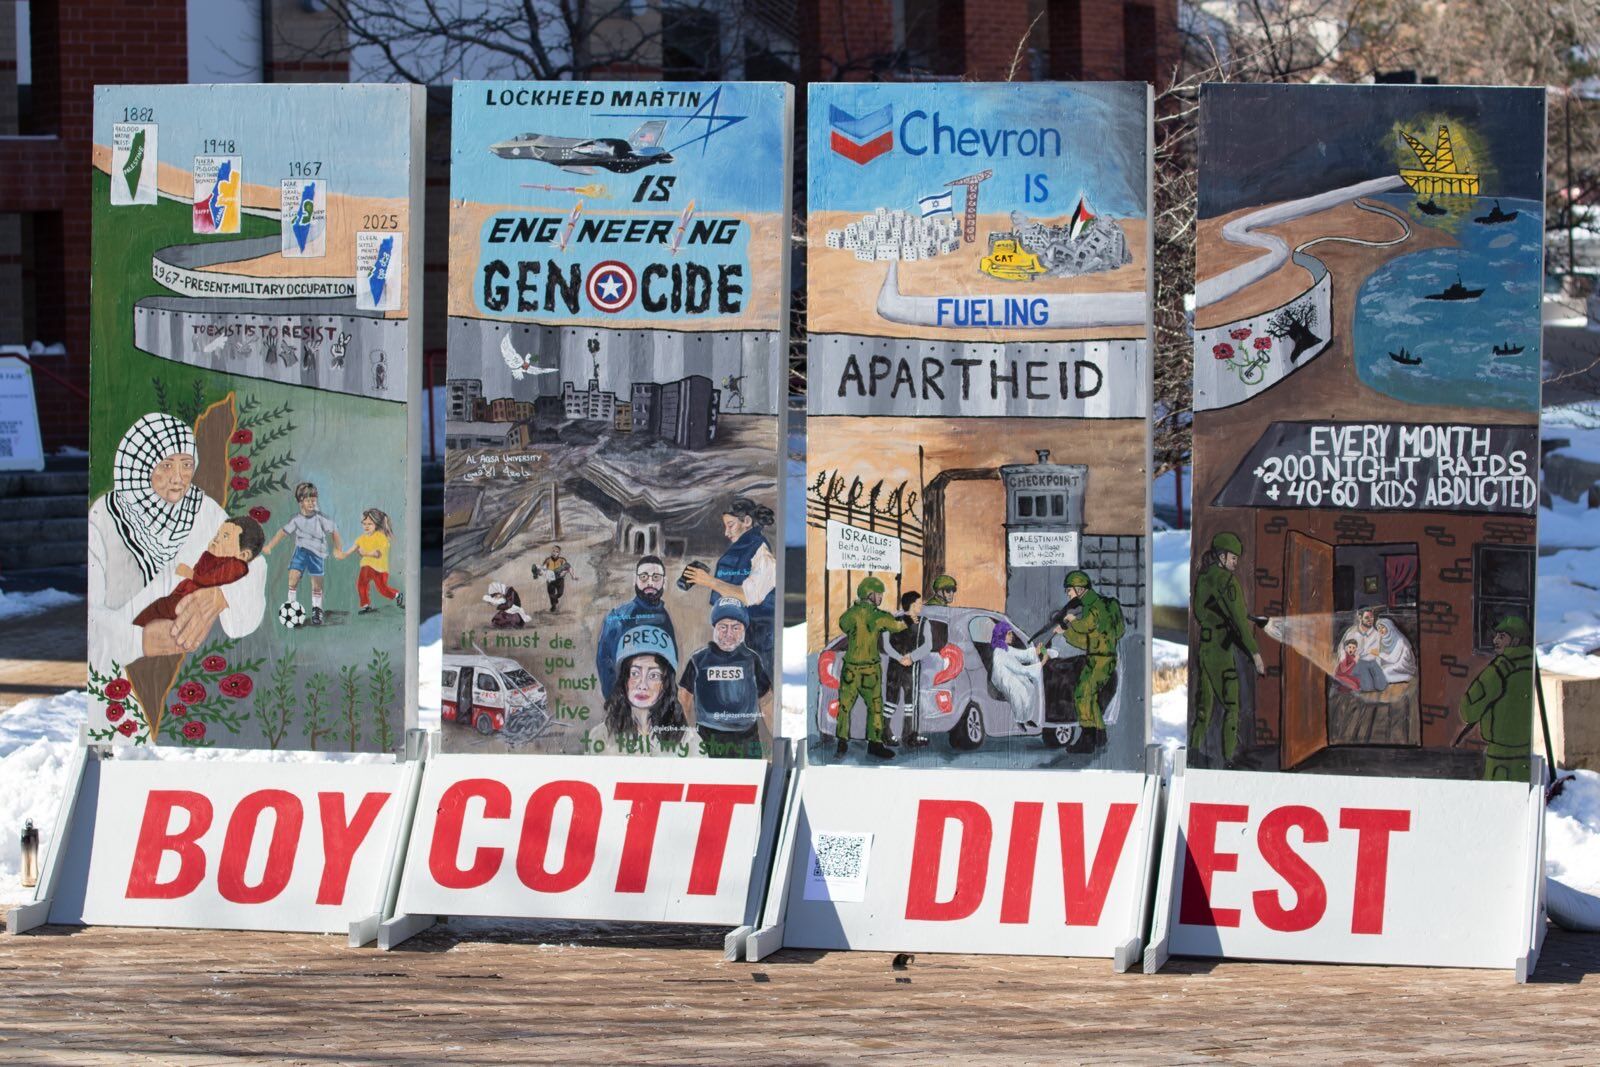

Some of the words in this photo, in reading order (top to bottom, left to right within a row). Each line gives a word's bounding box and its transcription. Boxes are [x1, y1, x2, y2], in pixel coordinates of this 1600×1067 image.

[486, 89, 604, 106] LOCKHEED
[611, 91, 701, 108] MARTIN
[123, 107, 153, 122] 1882
[900, 110, 1061, 157] Chevron
[204, 139, 235, 153] 1948
[289, 161, 322, 176] 1967
[632, 175, 676, 203] IS
[1024, 173, 1049, 203] IS
[363, 214, 398, 229] 2025
[994, 254, 1014, 263] CAT
[231, 283, 285, 295] MILITARY
[286, 283, 355, 295] OCCUPATION
[937, 298, 1050, 327] FUELING
[206, 325, 242, 337] EXIST
[258, 325, 279, 338] TO
[282, 325, 338, 340] RESIST
[837, 354, 1104, 400] APARTHEID
[1310, 424, 1391, 457] EVERY
[1400, 425, 1491, 458] MONTH
[465, 455, 477, 464] AL
[503, 454, 542, 463] UNIVERSITY
[1322, 456, 1421, 481] NIGHT
[1438, 451, 1528, 477] RAIDS
[1010, 475, 1079, 487] CHECKPOINT
[1287, 480, 1360, 507] 40-60
[1371, 479, 1419, 507] KIDS
[1424, 475, 1538, 508] ABDUCTED
[841, 527, 892, 547] ISRAELIS:
[1014, 535, 1073, 543] PALESTINIANS:
[838, 541, 859, 552] Beita
[862, 544, 886, 556] Village
[869, 562, 892, 570] through
[495, 632, 540, 648] must
[622, 628, 671, 649] PRESS
[544, 657, 575, 675] you
[708, 668, 742, 679] PRESS
[558, 673, 598, 690] must
[555, 698, 590, 720] live
[580, 730, 605, 754] to
[659, 740, 690, 758] my
[428, 778, 758, 896] COTT
[125, 788, 392, 906] BOY
[904, 799, 1139, 927] DIV
[1179, 802, 1411, 936] EST
